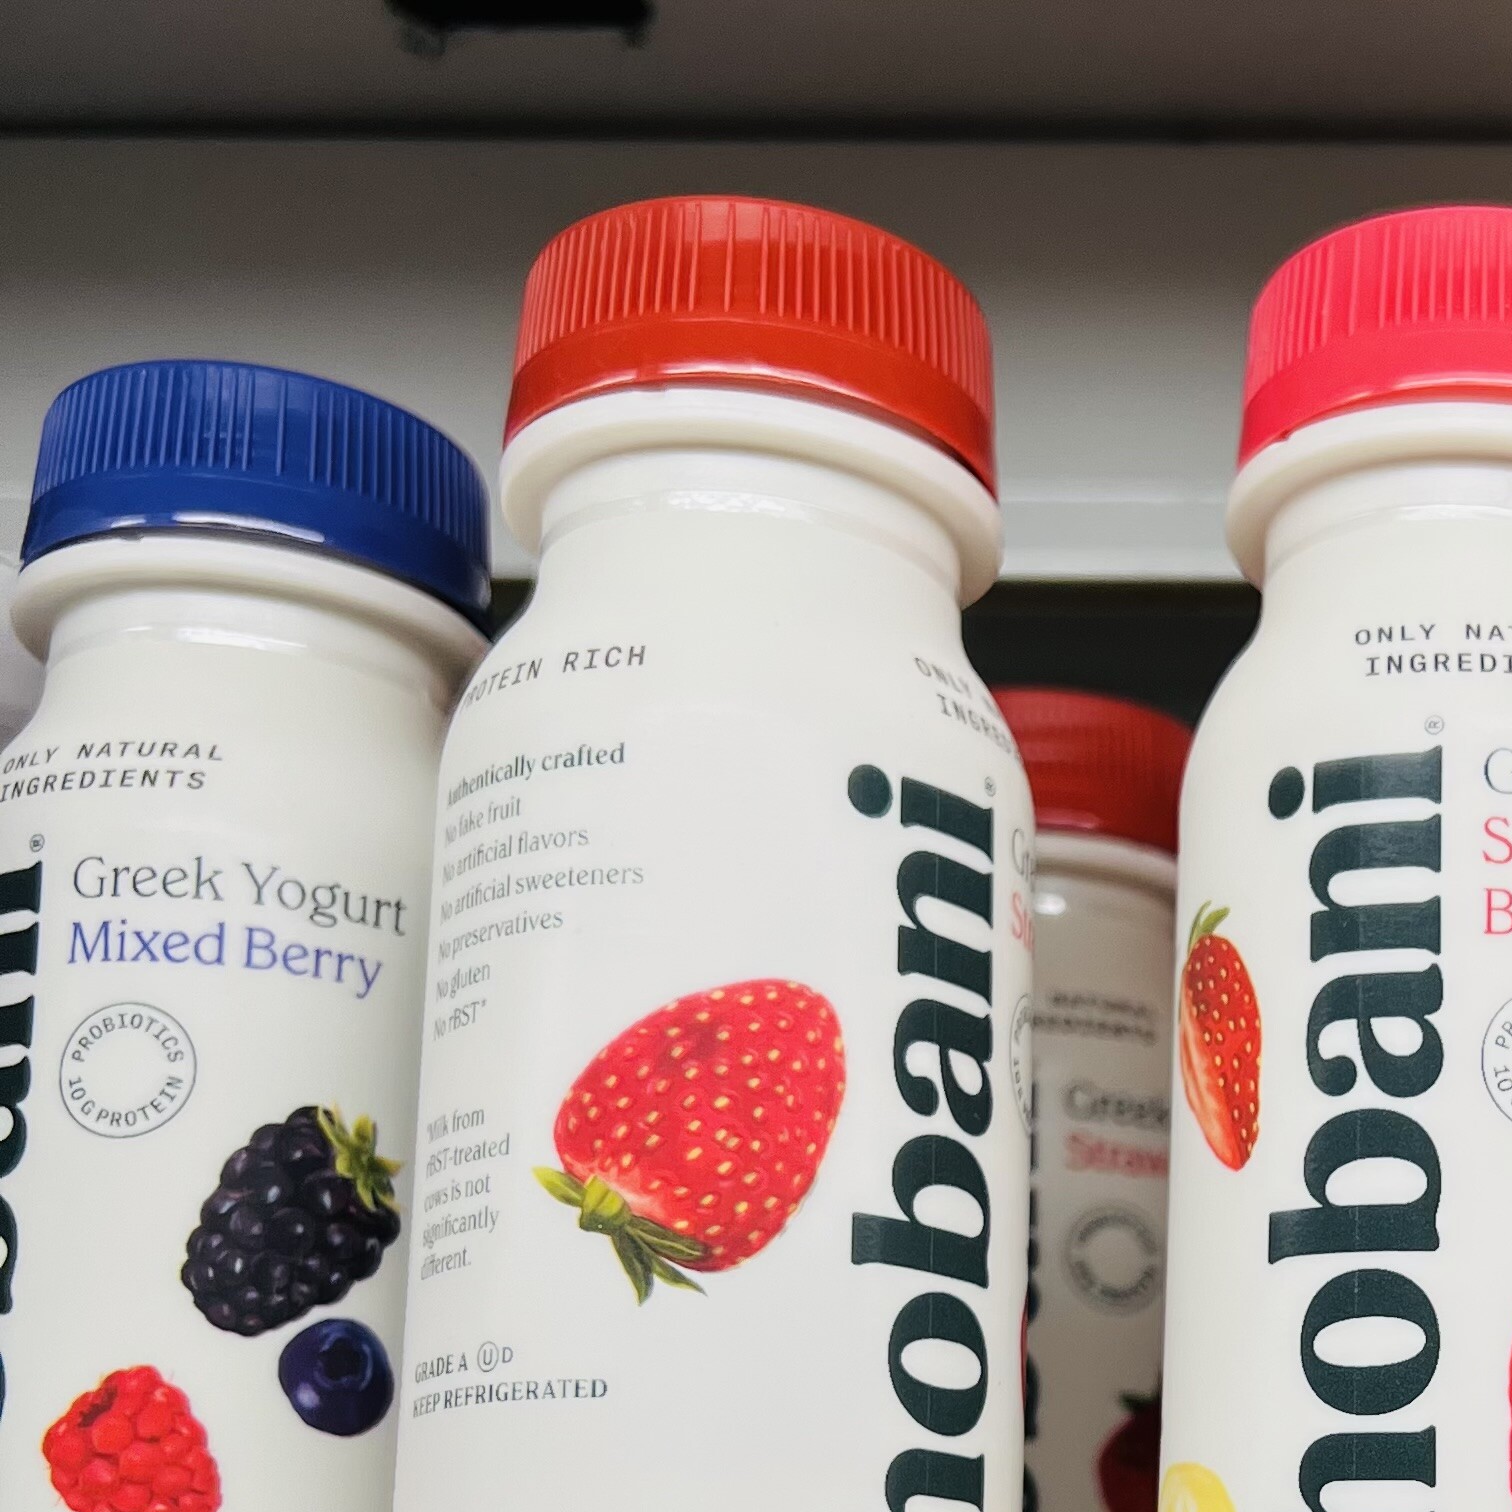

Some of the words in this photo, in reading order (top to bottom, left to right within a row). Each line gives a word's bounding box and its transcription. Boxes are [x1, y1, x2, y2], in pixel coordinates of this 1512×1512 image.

[1355, 624, 1437, 645] ONLY
[562, 645, 646, 673] RICH
[2, 744, 59, 775] ONLY
[77, 741, 224, 761] NATURAL
[541, 742, 625, 772] crafted
[0, 770, 206, 802] INGREDIENTS
[517, 828, 590, 857] flavors
[73, 855, 225, 902] Greek
[242, 861, 408, 937] Yogurt
[514, 864, 645, 897] sweeteners
[451, 910, 564, 960] preservatives
[67, 918, 226, 967] Mixed
[244, 926, 383, 1001] Berry
[70, 1011, 186, 1064] PROBIOTICS
[443, 1376, 609, 1410] REFRIGERATED
